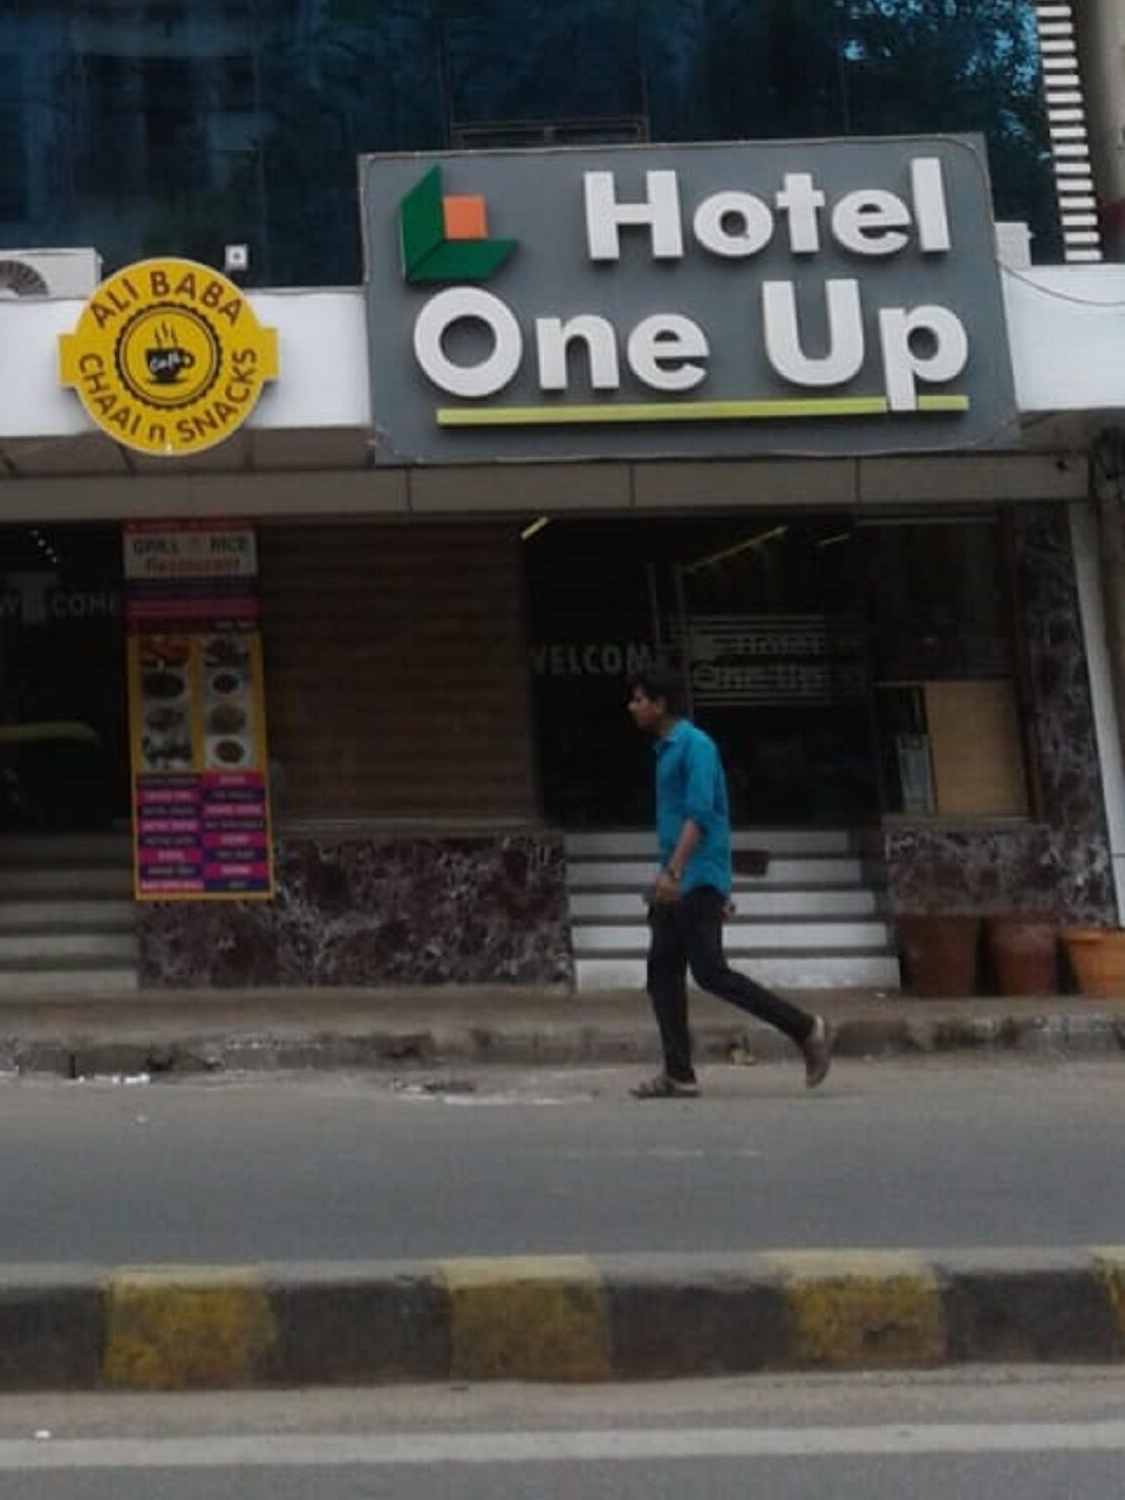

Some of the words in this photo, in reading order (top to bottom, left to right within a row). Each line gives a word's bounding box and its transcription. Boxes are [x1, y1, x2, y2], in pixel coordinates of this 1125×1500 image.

[584, 157, 951, 259] Hotel
[90, 277, 139, 329] ALI
[150, 271, 242, 327] BABA
[414, 286, 710, 397] One
[762, 279, 968, 411] Up
[80, 353, 142, 436] CHAAI
[176, 348, 257, 443] SNACKS
